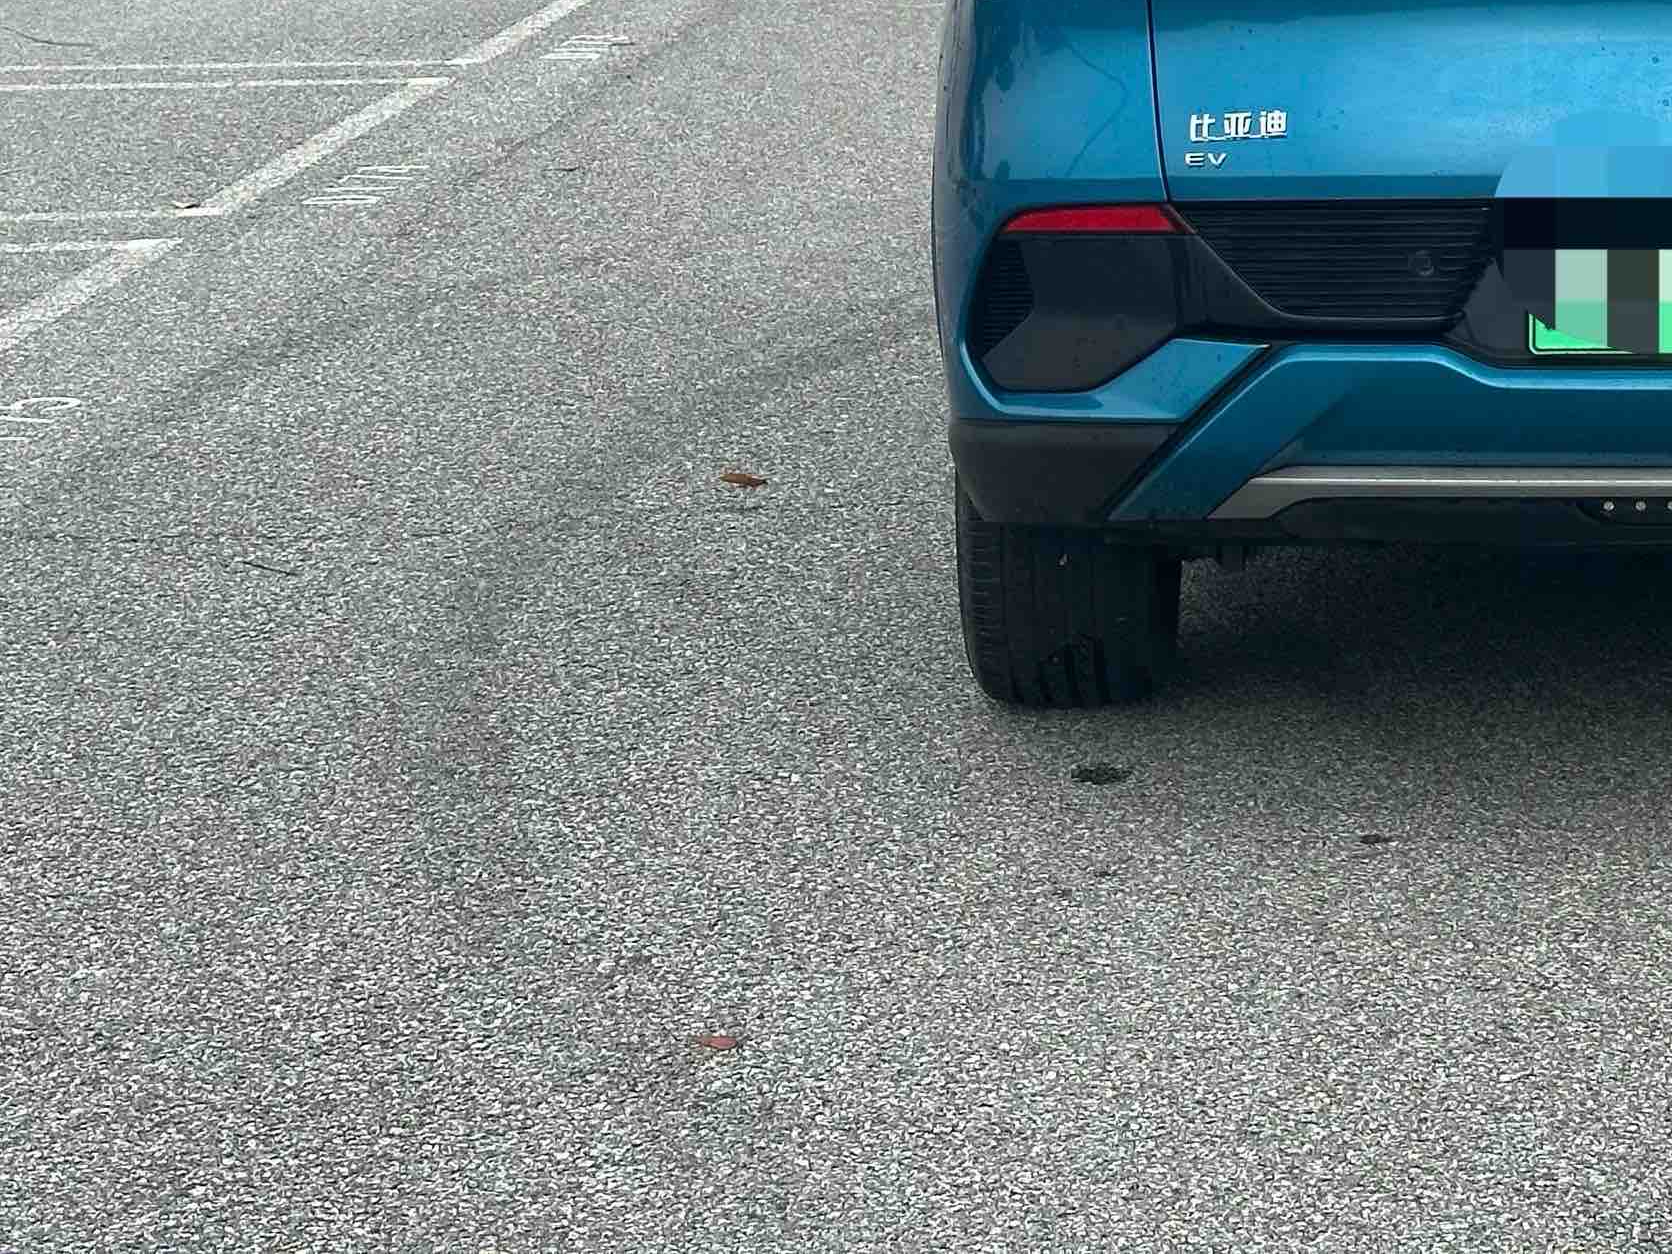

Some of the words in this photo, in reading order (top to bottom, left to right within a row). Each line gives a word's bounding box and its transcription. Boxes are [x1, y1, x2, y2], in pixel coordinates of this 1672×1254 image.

[1190, 109, 1288, 142] 比亚迪
[1184, 152, 1227, 166] EV
